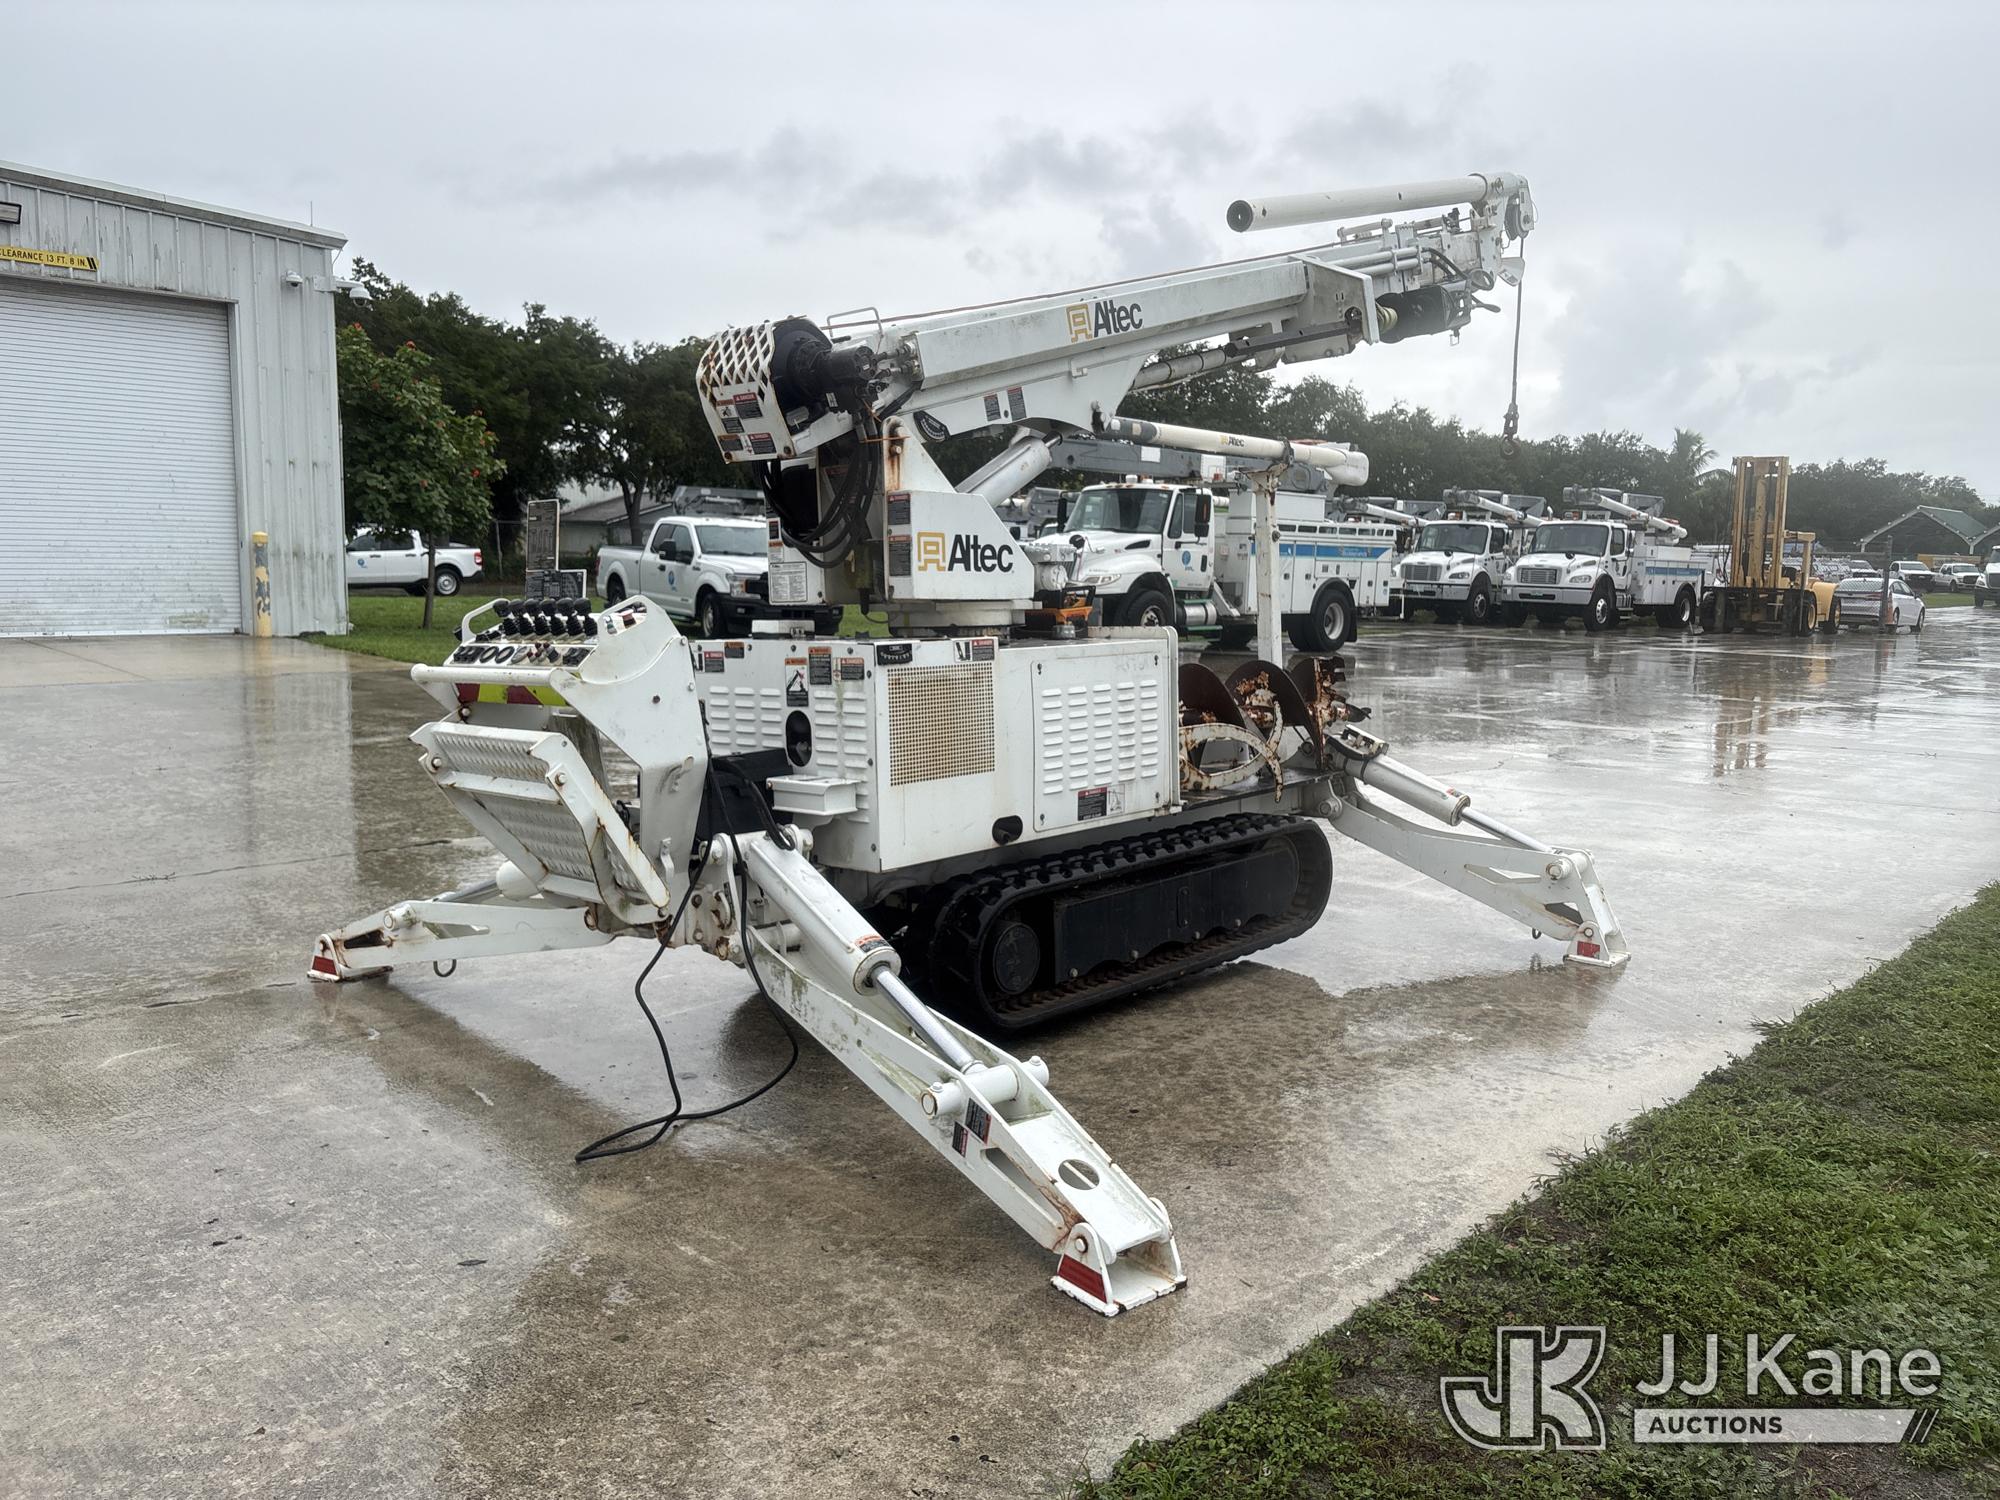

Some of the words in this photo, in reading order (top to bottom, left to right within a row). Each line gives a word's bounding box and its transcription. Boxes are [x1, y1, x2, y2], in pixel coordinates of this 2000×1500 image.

[46, 254, 54, 263] 13
[57, 255, 68, 265] FT.
[70, 257, 75, 265] 8
[77, 258, 87, 267] IN.
[1094, 299, 1143, 338] Altec
[947, 534, 1013, 573] Altec
